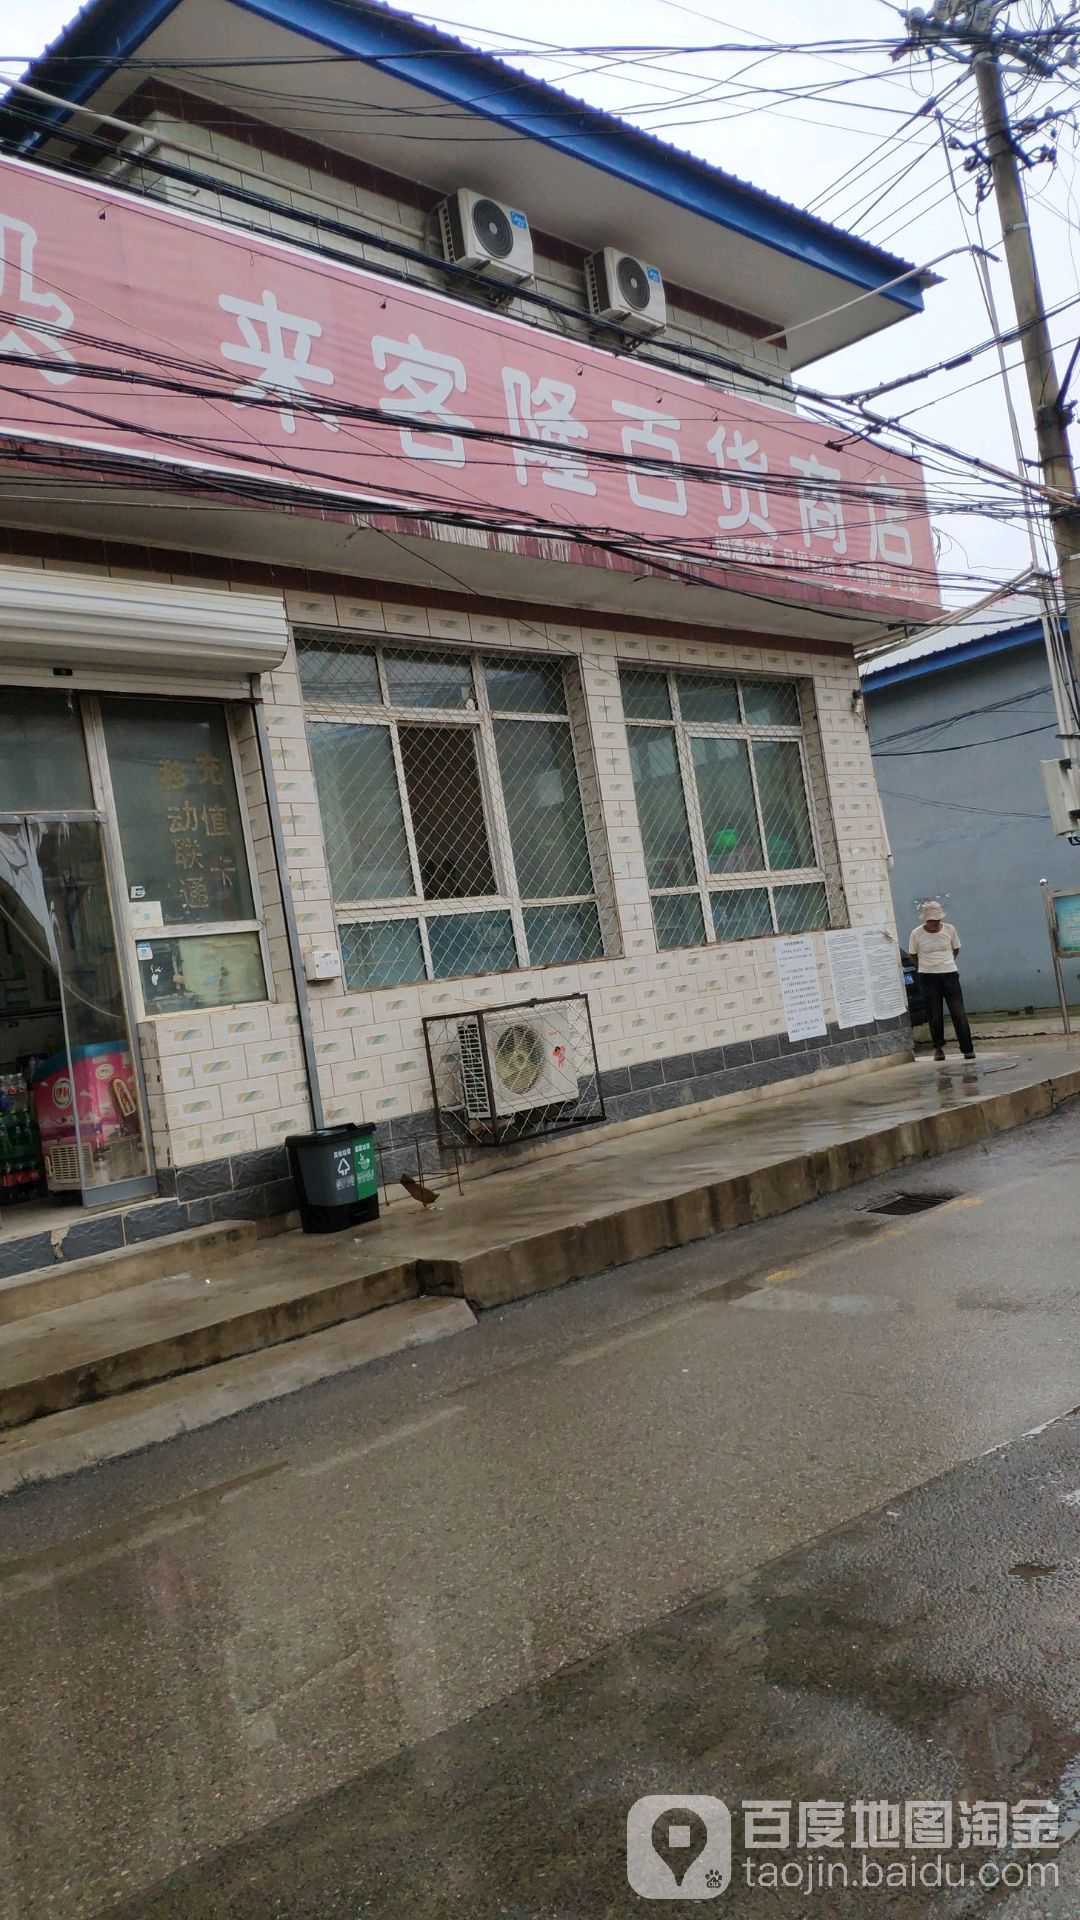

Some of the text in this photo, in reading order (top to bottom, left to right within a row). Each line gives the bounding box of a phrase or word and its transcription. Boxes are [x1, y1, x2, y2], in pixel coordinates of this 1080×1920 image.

[218, 289, 912, 567] 来客隆百货商店
